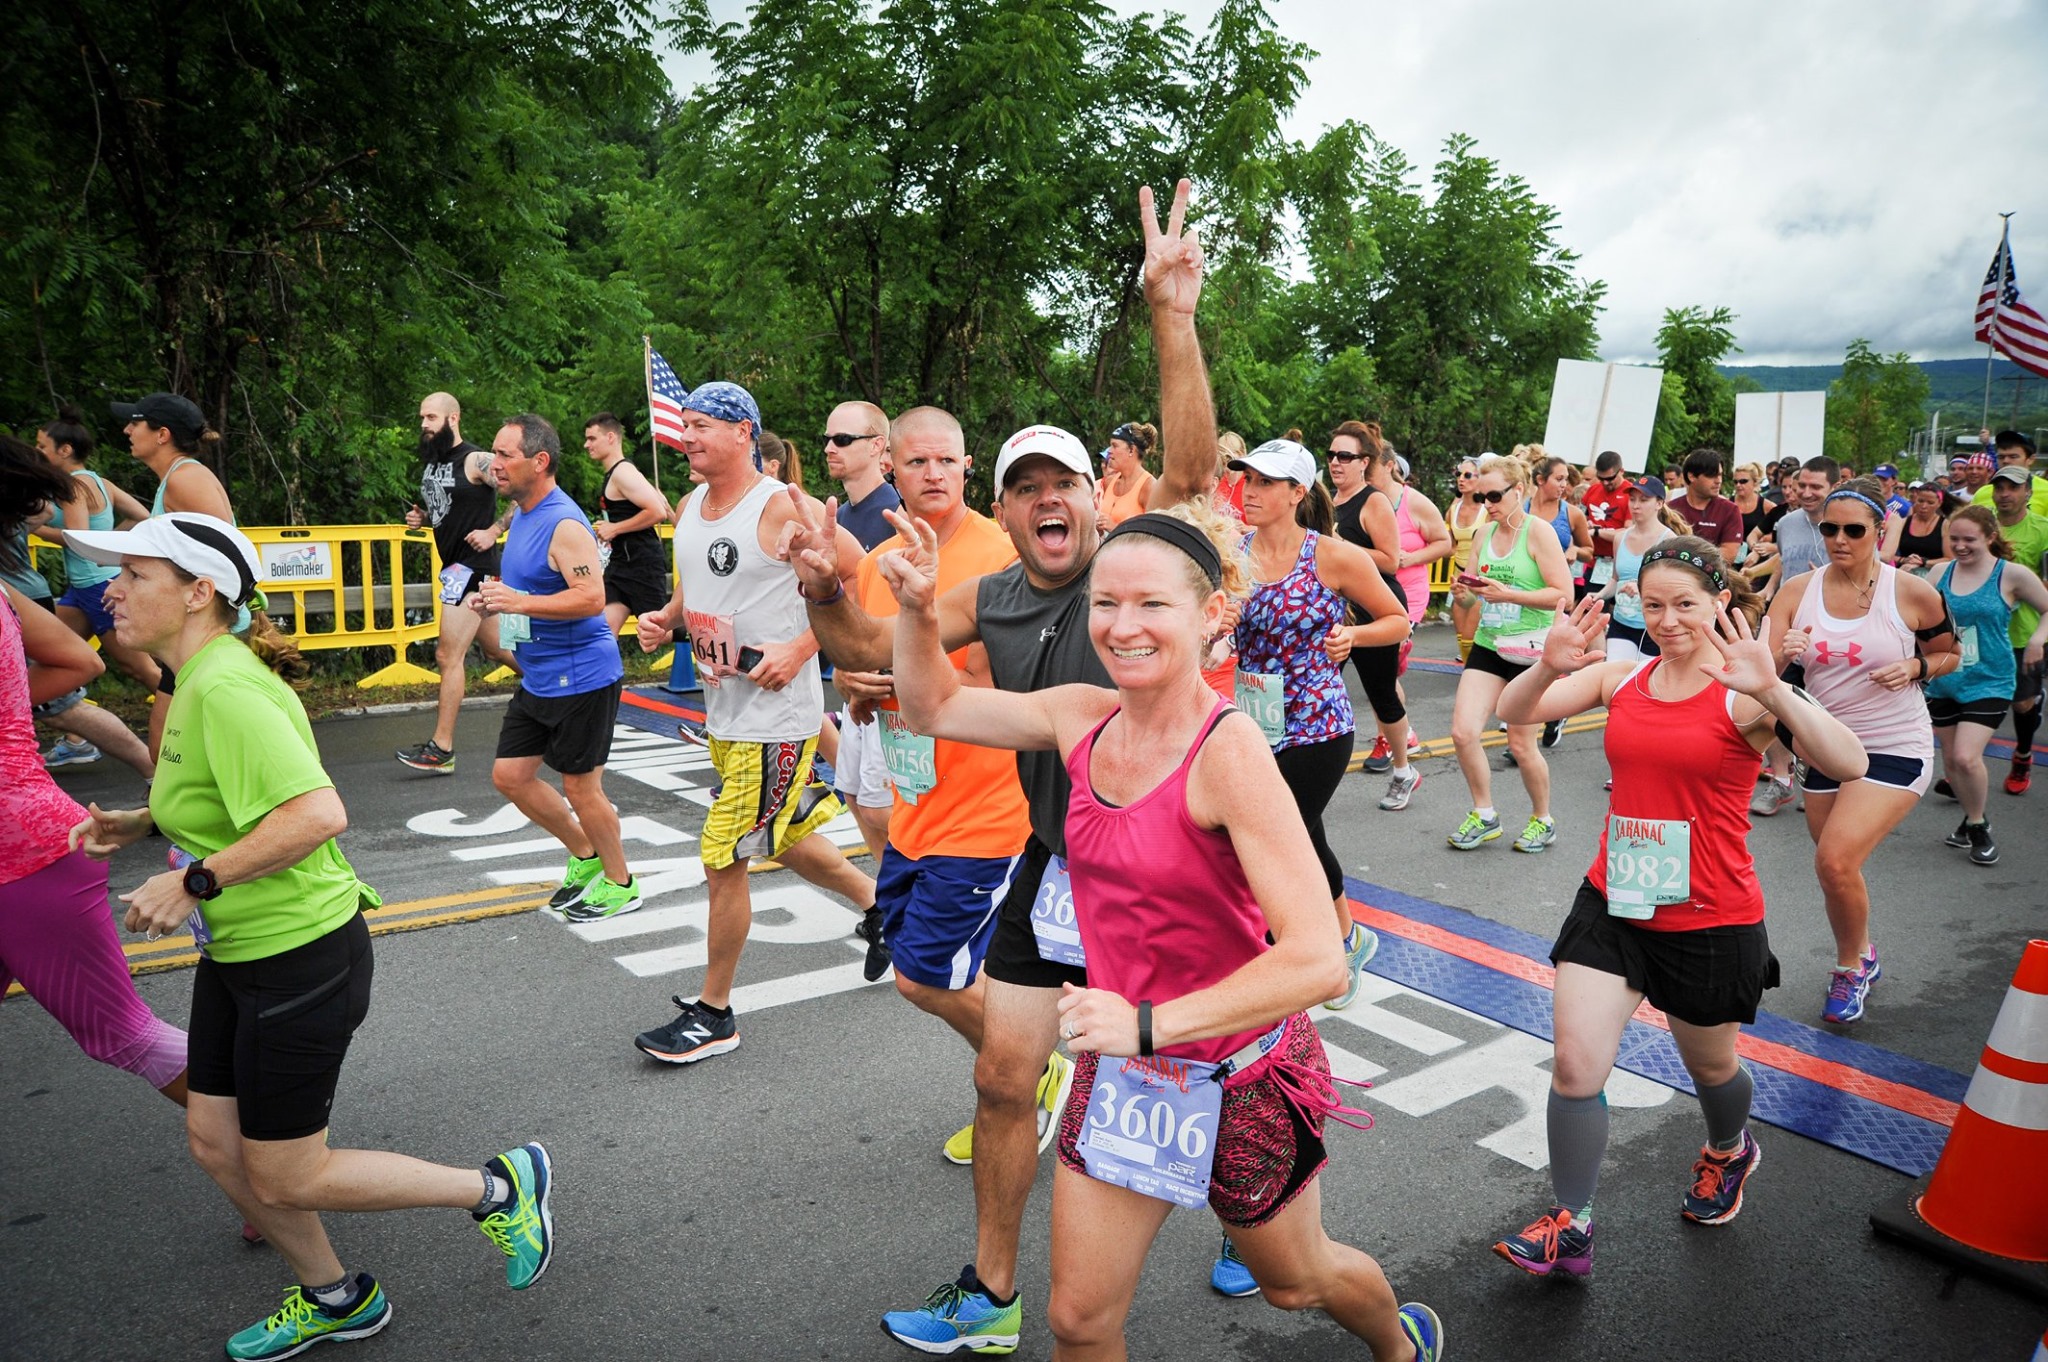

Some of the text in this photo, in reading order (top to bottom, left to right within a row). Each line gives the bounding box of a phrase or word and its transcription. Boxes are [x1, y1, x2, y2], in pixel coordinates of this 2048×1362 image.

[271, 562, 324, 577] Boilermaker
[1614, 818, 1667, 847] SARANAC
[1088, 1081, 1213, 1159] 3606
